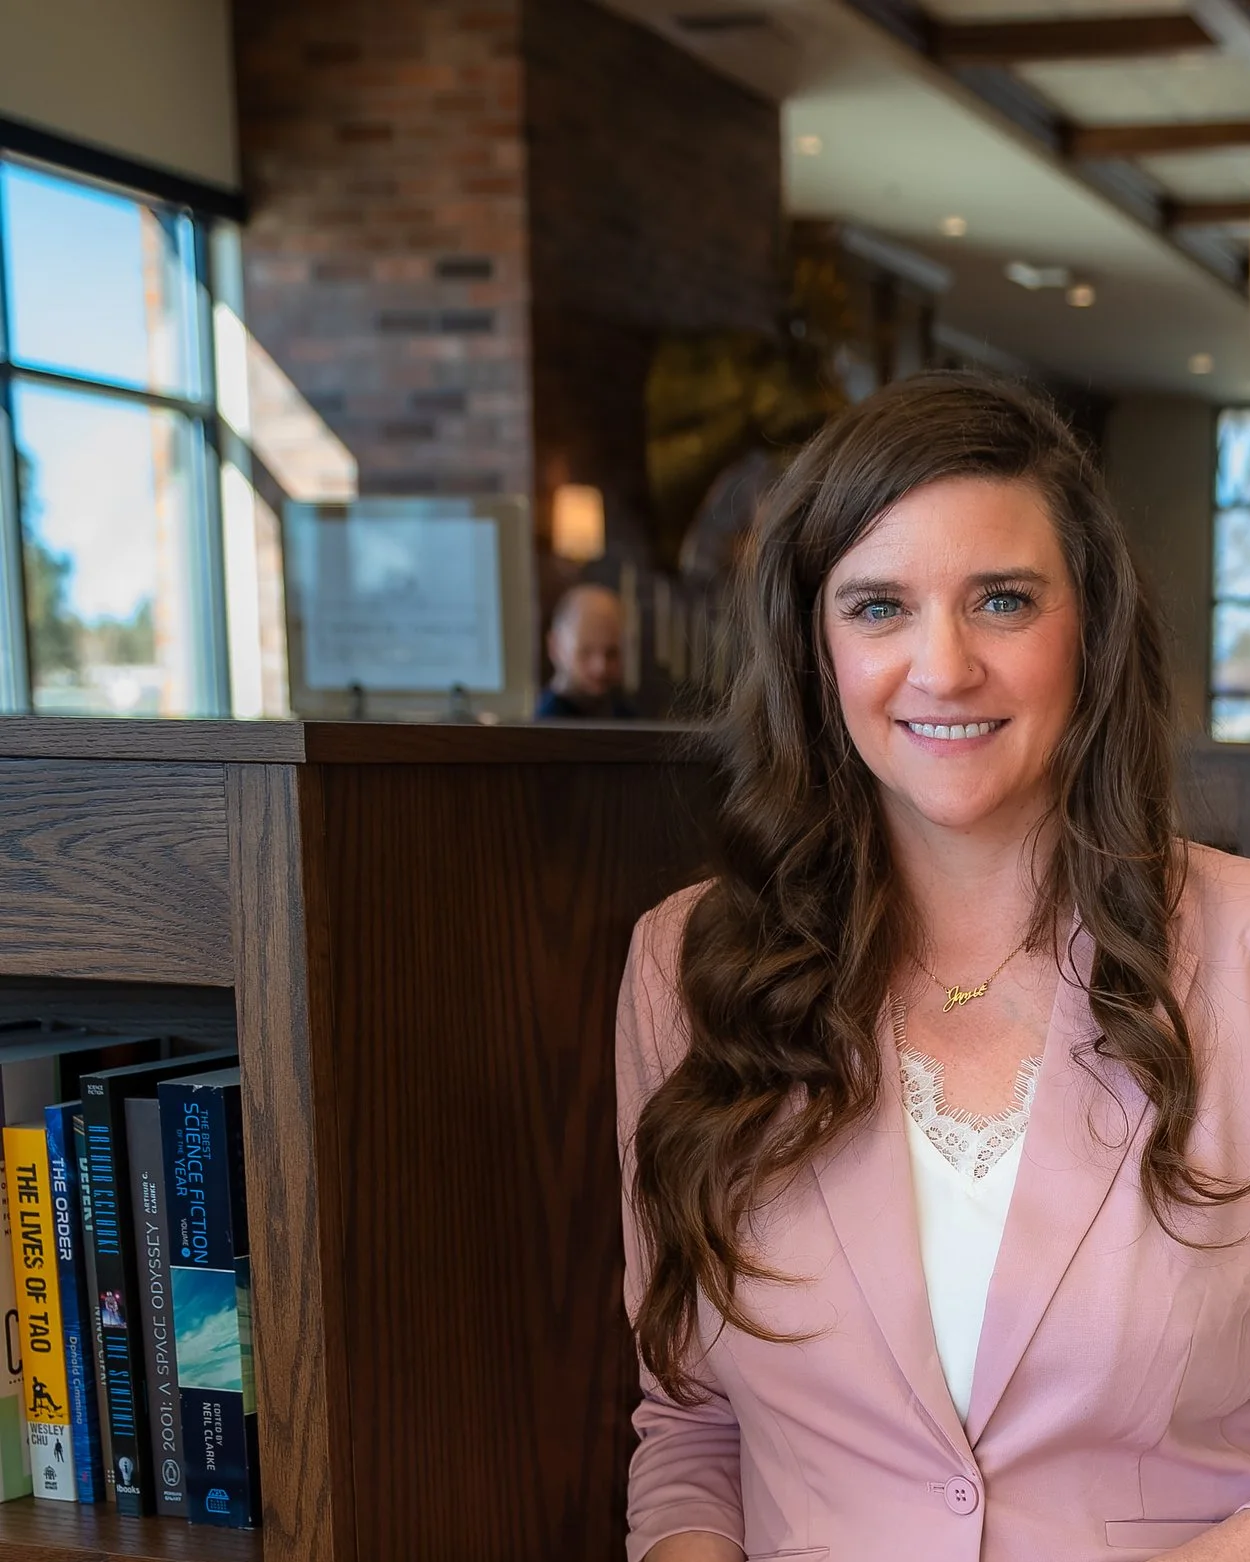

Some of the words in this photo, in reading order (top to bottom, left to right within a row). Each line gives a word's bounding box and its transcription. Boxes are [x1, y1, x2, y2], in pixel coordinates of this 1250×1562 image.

[176, 1129, 182, 1138] OF
[200, 1110, 208, 1129] THE
[88, 1126, 114, 1182] ARTHUR
[184, 1103, 204, 1182] SCIENCE
[201, 1133, 211, 1160] BEST
[16, 1163, 38, 1204] THE
[52, 1158, 67, 1192] THE
[142, 1171, 148, 1180] C.
[175, 1158, 187, 1196] YEAR
[142, 1180, 152, 1214] ARTHUR
[148, 1182, 157, 1214] CLARKE
[20, 1211, 44, 1269] LIVES
[55, 1198, 72, 1262] ORDER
[190, 1190, 208, 1264] FICTION
[146, 1221, 164, 1309] ODYSSEY
[25, 1276, 47, 1304] OF
[29, 1312, 51, 1353] TAO
[106, 1336, 128, 1359] THE
[154, 1316, 169, 1376] SPACE
[69, 1336, 80, 1376] Donald
[73, 1378, 84, 1425] Cimmino
[108, 1370, 134, 1436] SENTINEL
[203, 1402, 212, 1427] NEIL
[214, 1403, 222, 1434] EDITED
[30, 1422, 64, 1436] WESLEY
[31, 1434, 48, 1446] CHU
[160, 1402, 176, 1451] 2001:
[216, 1435, 222, 1446] BY
[204, 1430, 216, 1471] CLARKE
